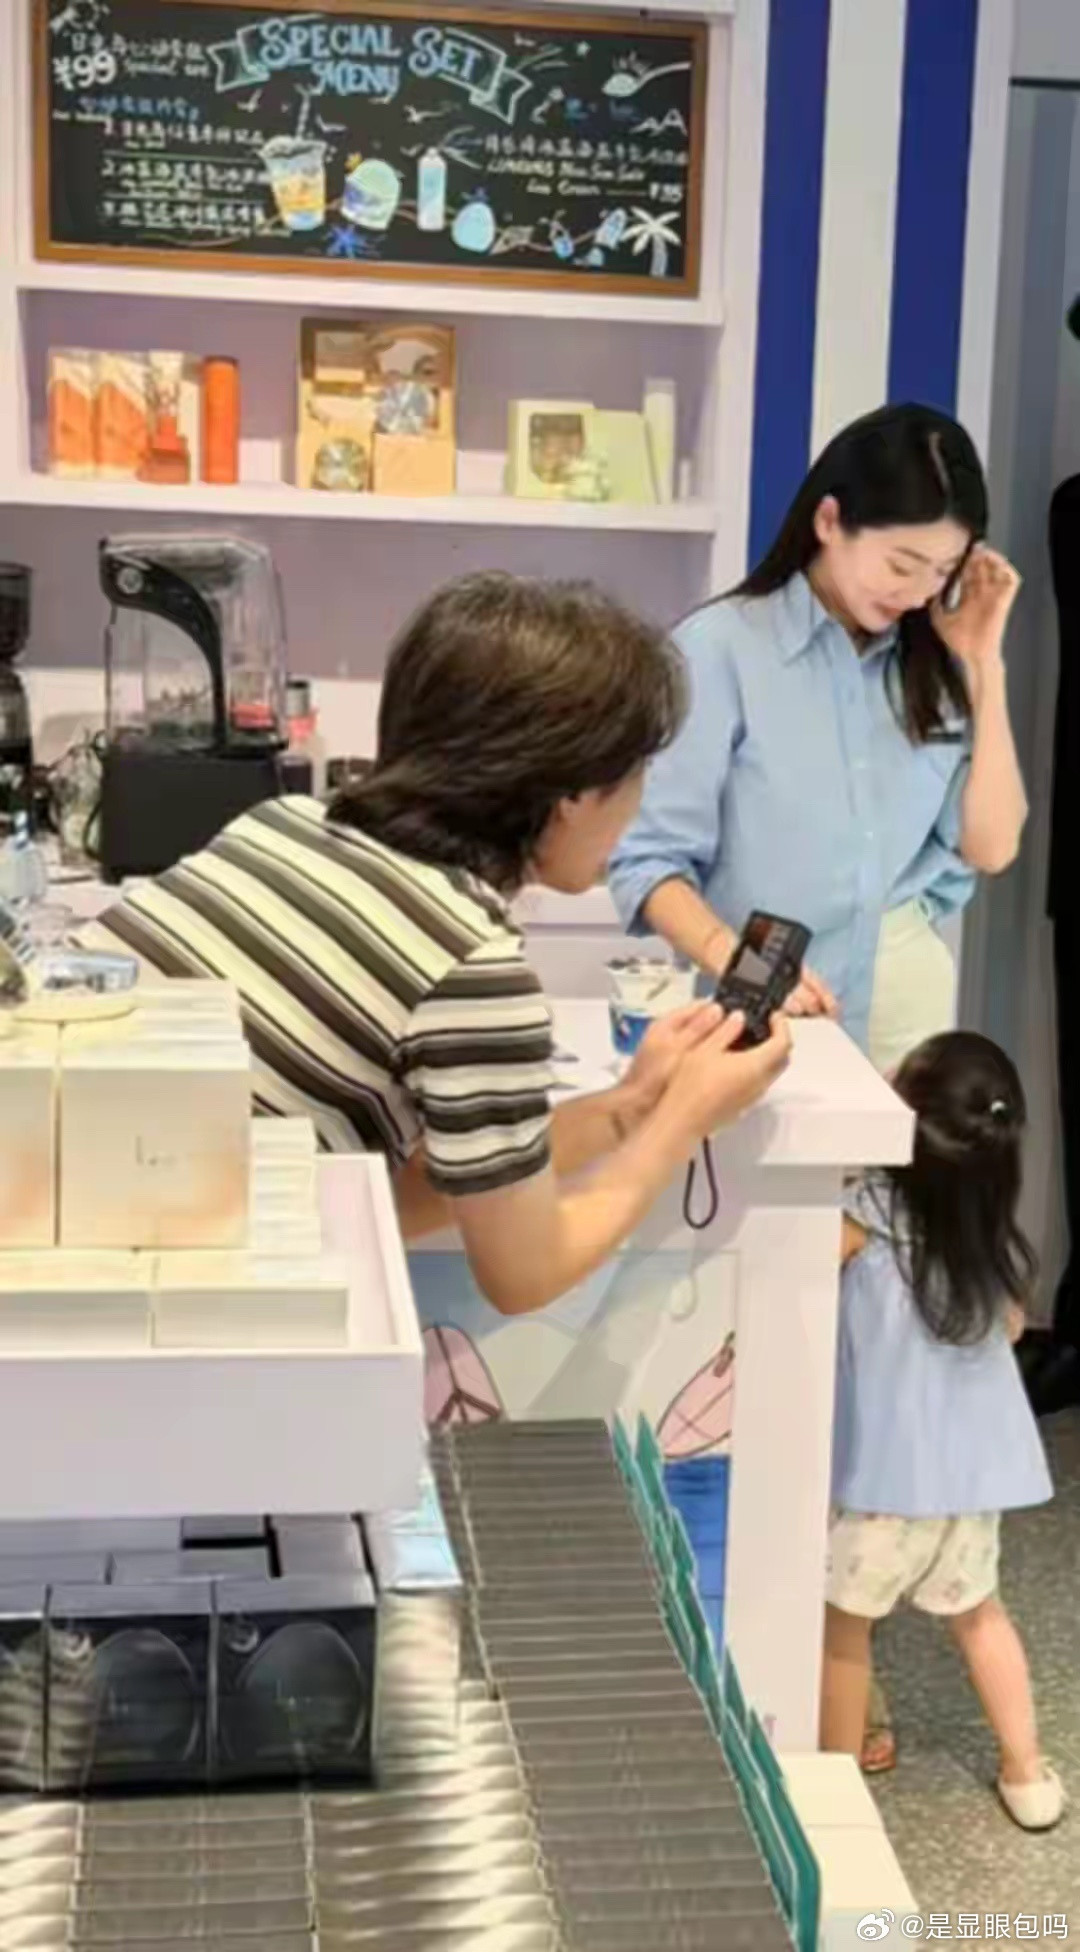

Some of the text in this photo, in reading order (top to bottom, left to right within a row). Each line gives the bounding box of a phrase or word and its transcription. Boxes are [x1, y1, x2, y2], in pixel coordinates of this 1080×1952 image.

[53, 51, 117, 89] ¥99
[260, 18, 401, 70] SPECIAL
[408, 27, 481, 81] SET
[309, 58, 402, 104] MENU
